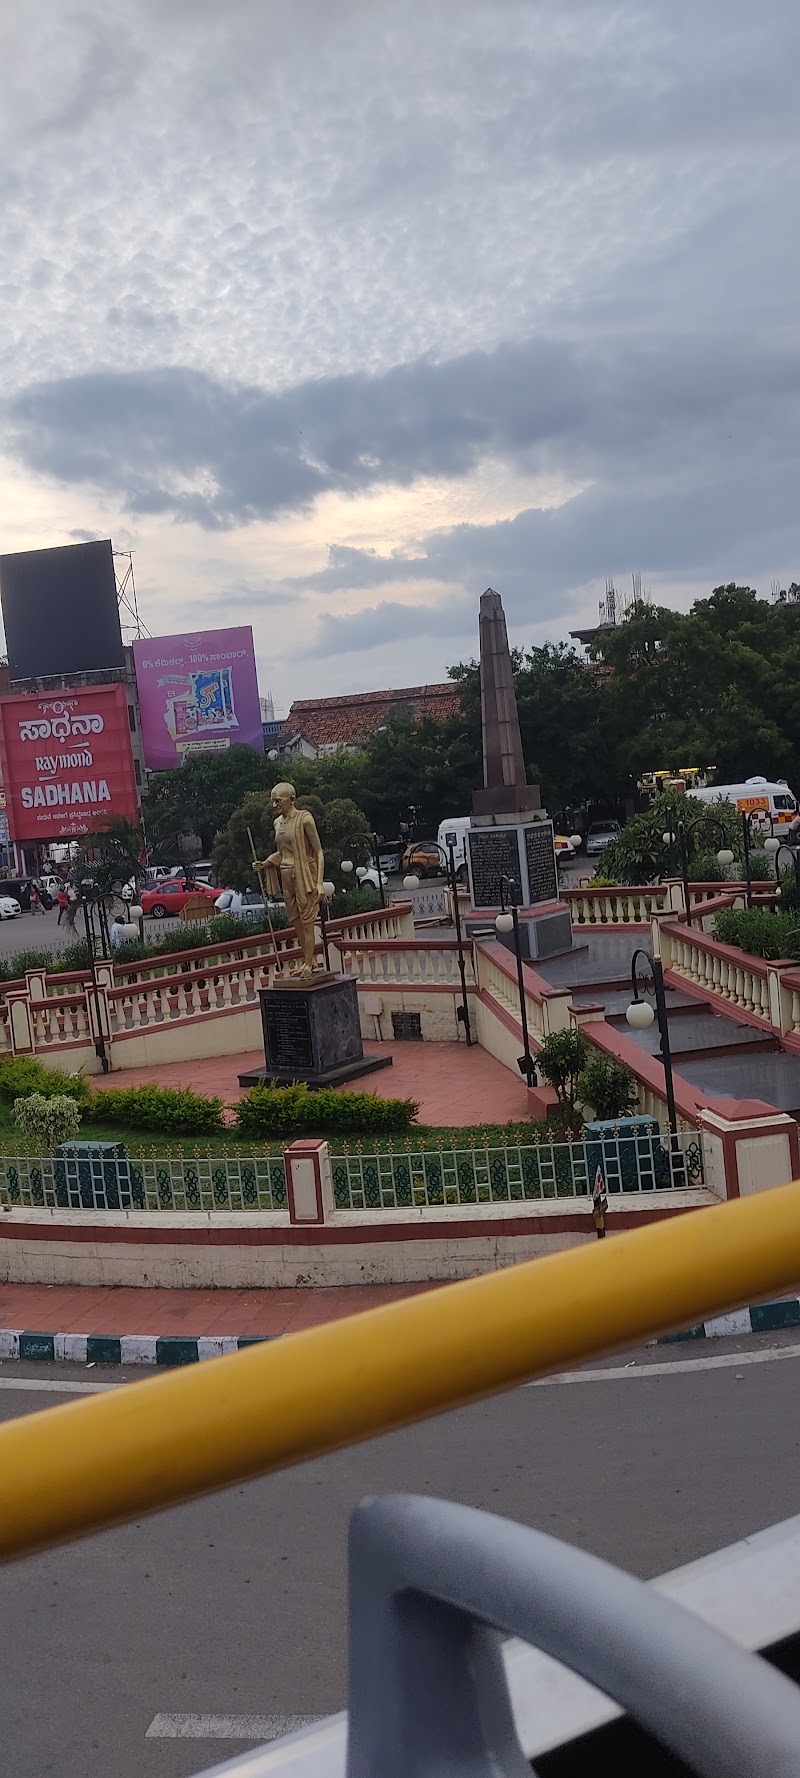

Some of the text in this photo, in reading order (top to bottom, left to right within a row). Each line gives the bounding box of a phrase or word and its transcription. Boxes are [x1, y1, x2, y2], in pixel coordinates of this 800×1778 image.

[18, 710, 104, 743] ಸಾಧನಾ
[35, 749, 93, 775] Raymond
[21, 780, 111, 808] SADHANA
[745, 797, 766, 806] 1033
